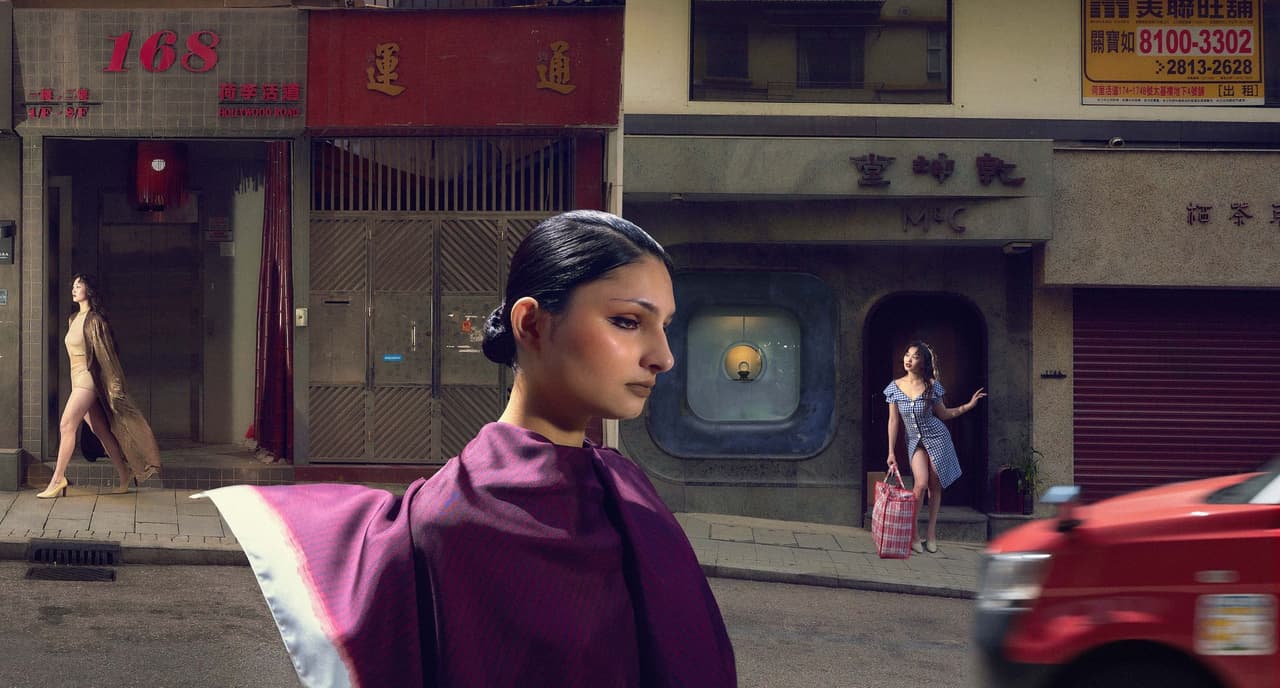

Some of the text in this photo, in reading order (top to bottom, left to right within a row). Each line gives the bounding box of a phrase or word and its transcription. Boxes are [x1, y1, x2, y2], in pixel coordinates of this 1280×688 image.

[102, 29, 220, 73] 168
[1139, 28, 1253, 54] 8100-3302
[1167, 59, 1253, 75] 2813-2628
